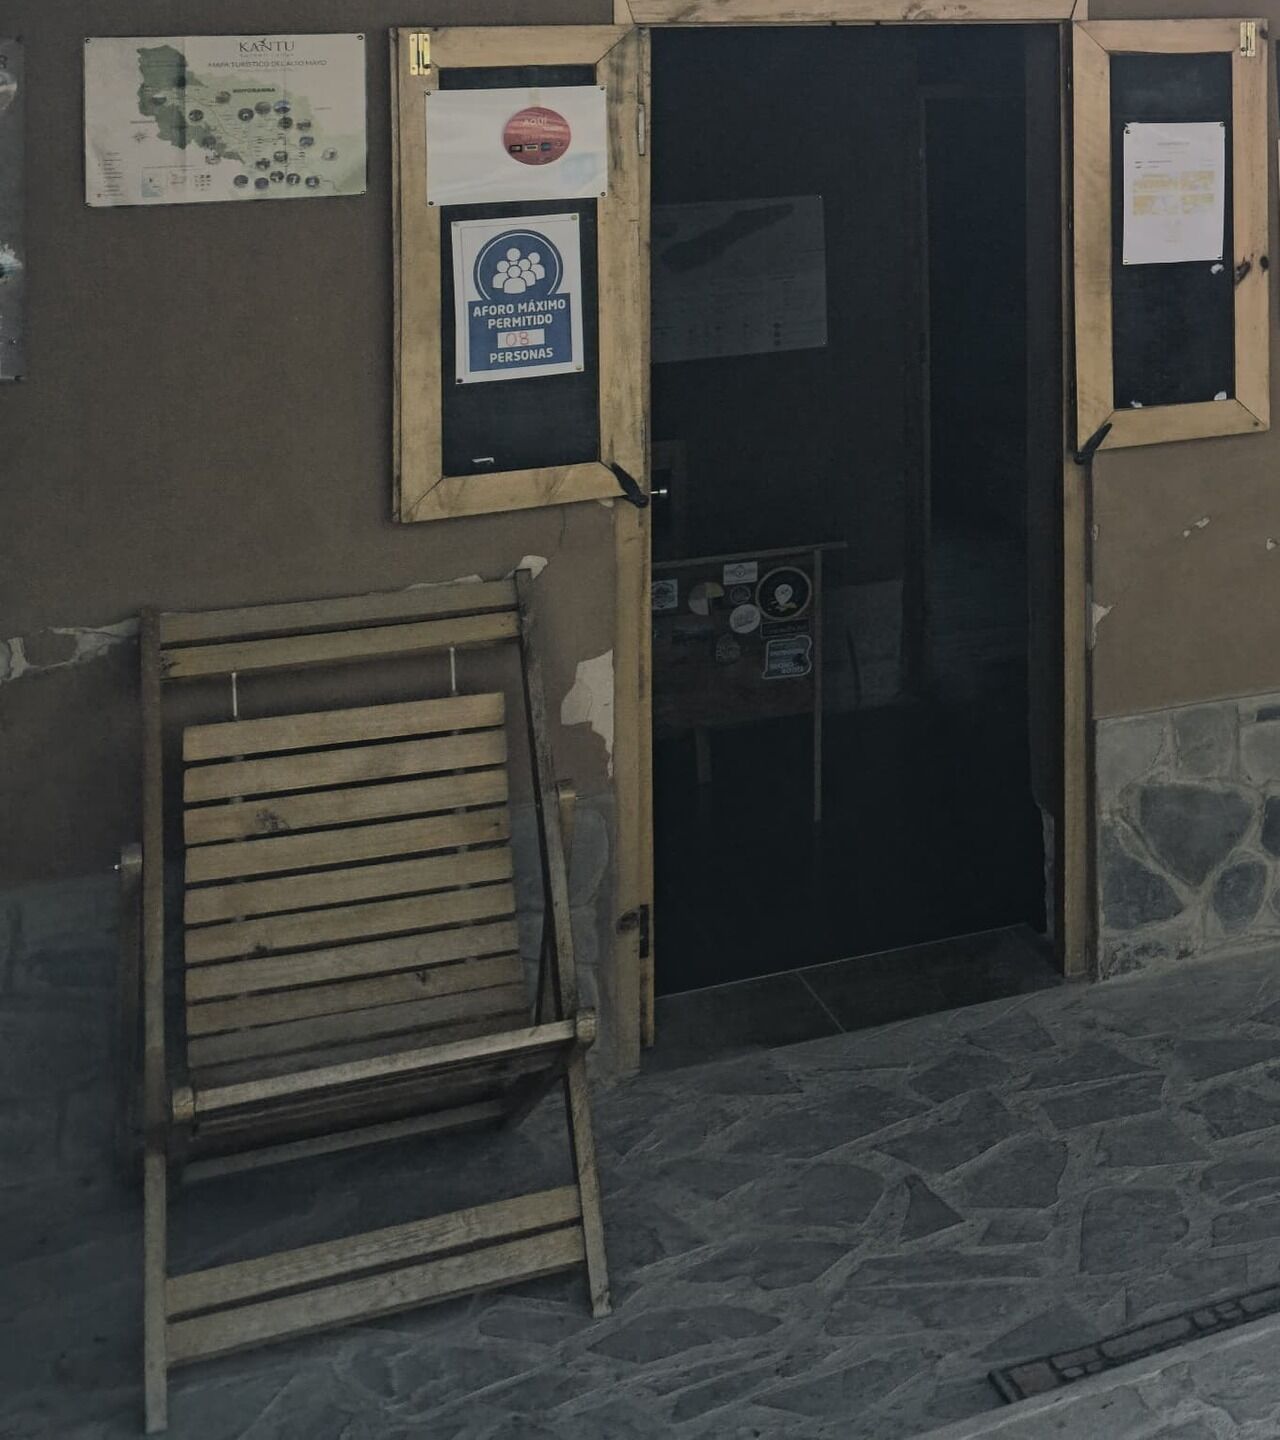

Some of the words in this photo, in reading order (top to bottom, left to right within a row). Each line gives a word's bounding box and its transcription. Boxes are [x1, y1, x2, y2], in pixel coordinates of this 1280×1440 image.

[239, 39, 295, 52] KANTU
[473, 304, 514, 317] AFORO
[518, 299, 566, 313] MÁXIMO
[487, 314, 553, 329] PERMITIDO
[506, 332, 529, 346] 08
[489, 347, 554, 363] PERSONAS
